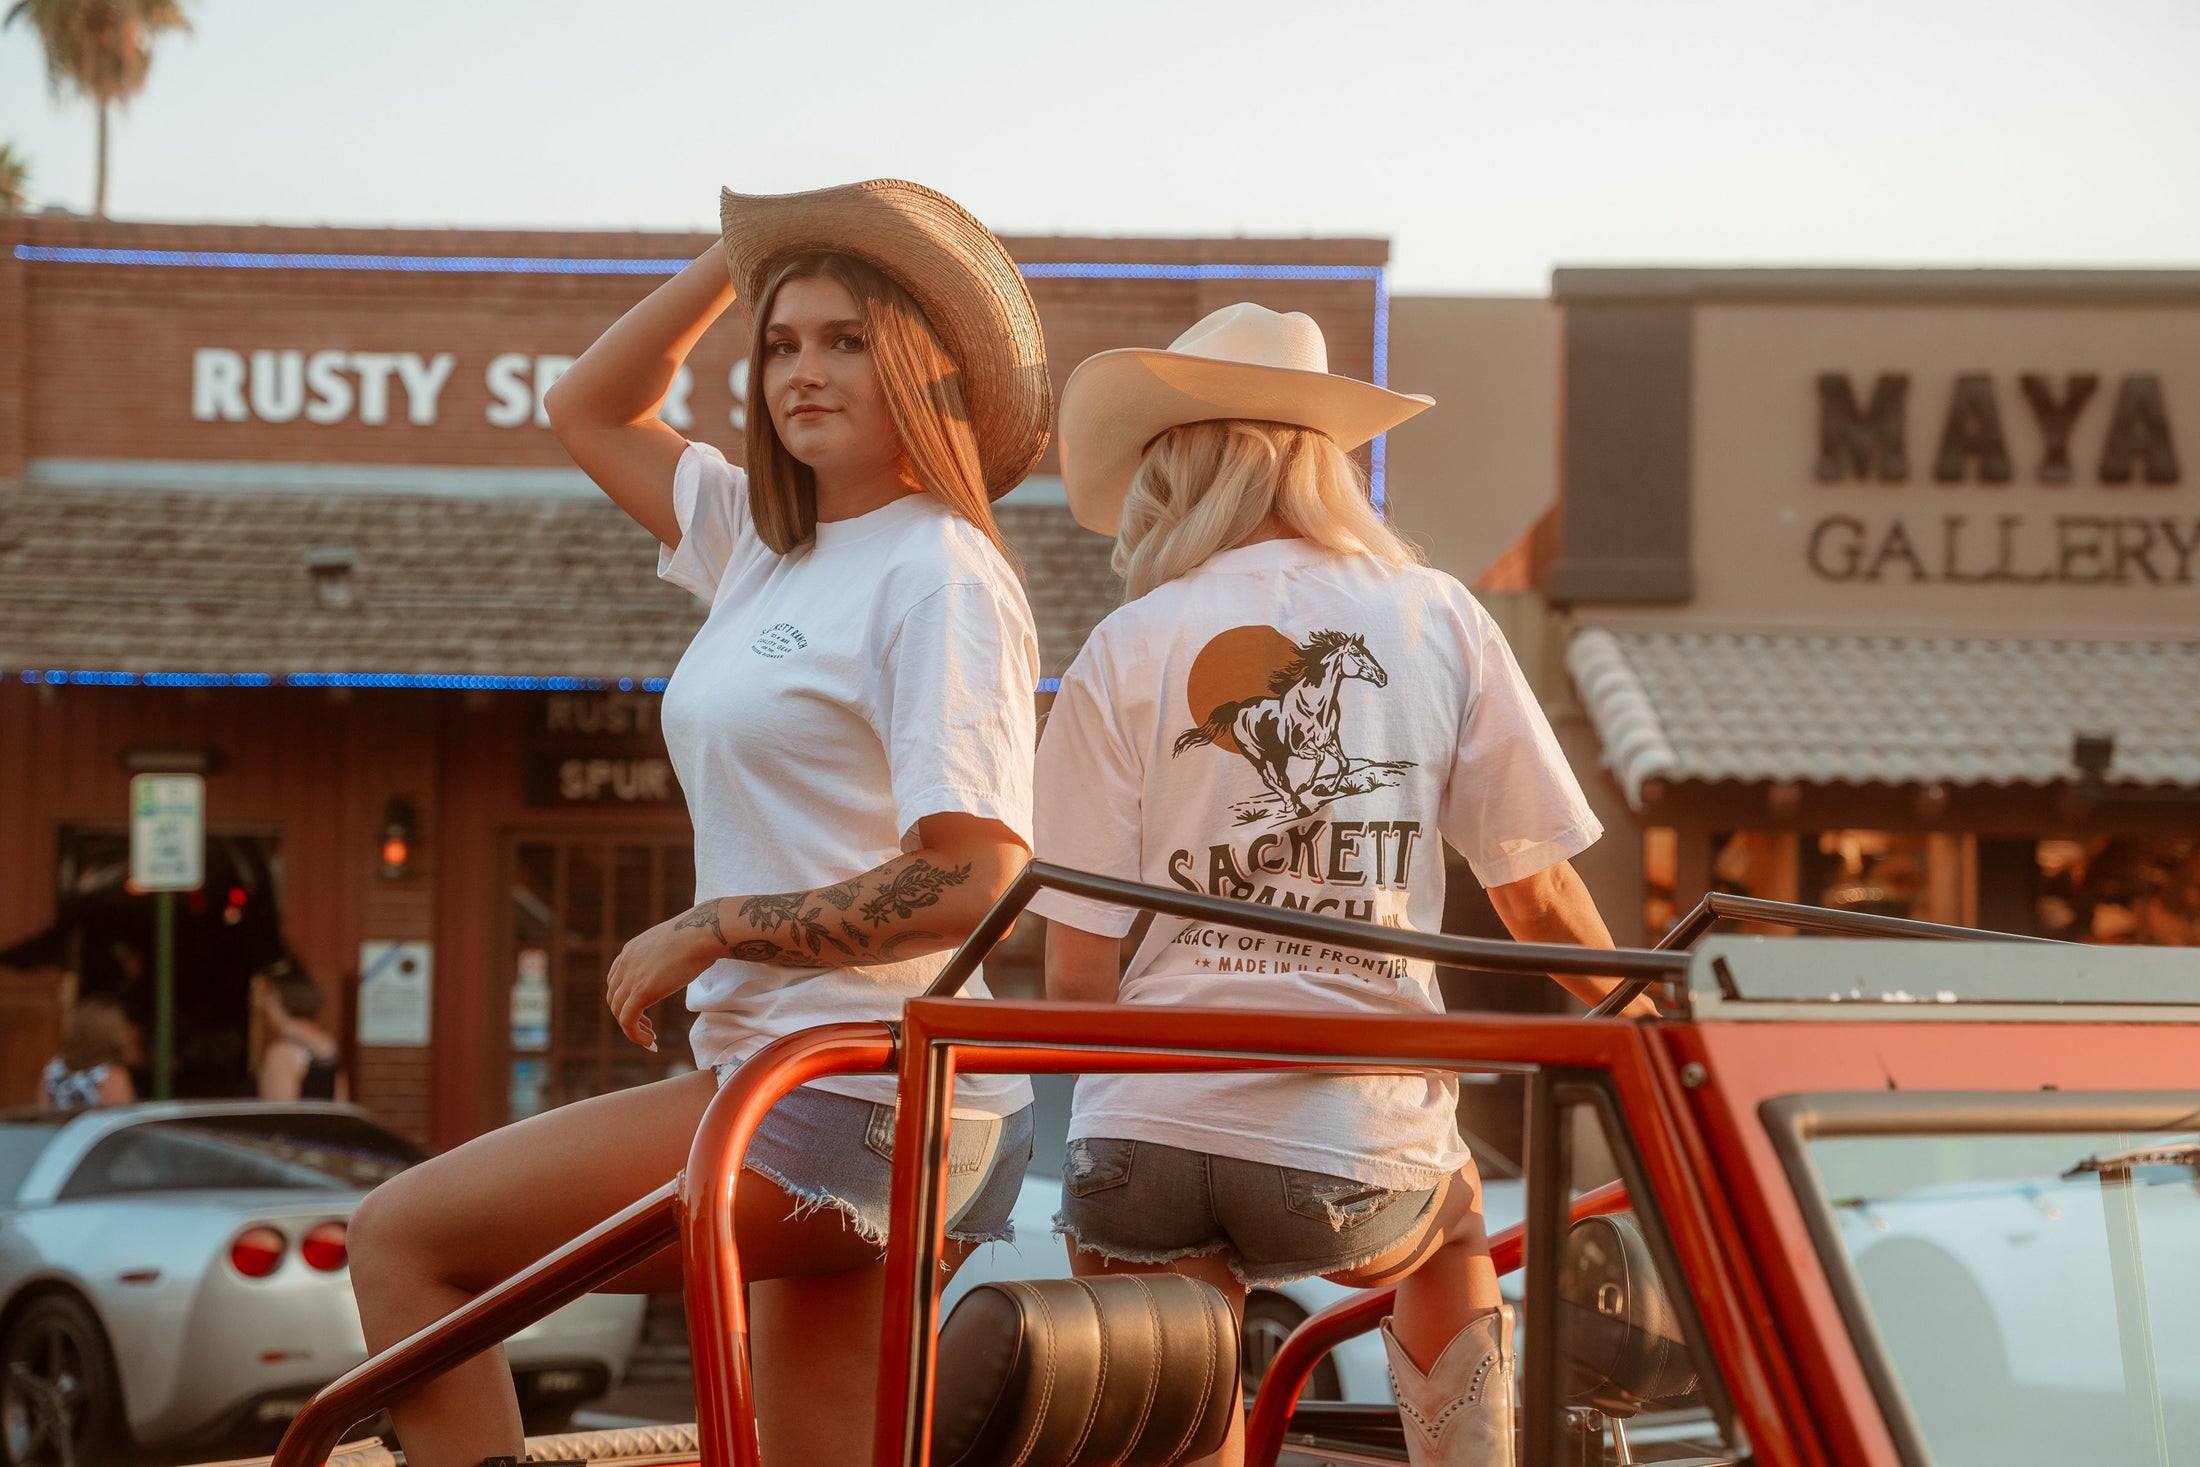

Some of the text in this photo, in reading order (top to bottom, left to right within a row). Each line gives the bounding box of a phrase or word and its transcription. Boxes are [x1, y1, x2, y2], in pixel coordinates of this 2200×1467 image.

[192, 347, 454, 426] RUSTY
[484, 352, 695, 430] SPR
[1814, 372, 2182, 484] MAYA
[1807, 512, 2200, 587] GALLERY
[548, 693, 659, 733] RUST
[559, 759, 672, 801] SPUR
[1168, 820, 1423, 896] SACKETT
[1171, 928, 1408, 979] EGACY OF THE FRONTIER
[1218, 956, 1267, 975] MADE
[1273, 961, 1291, 974] IN
